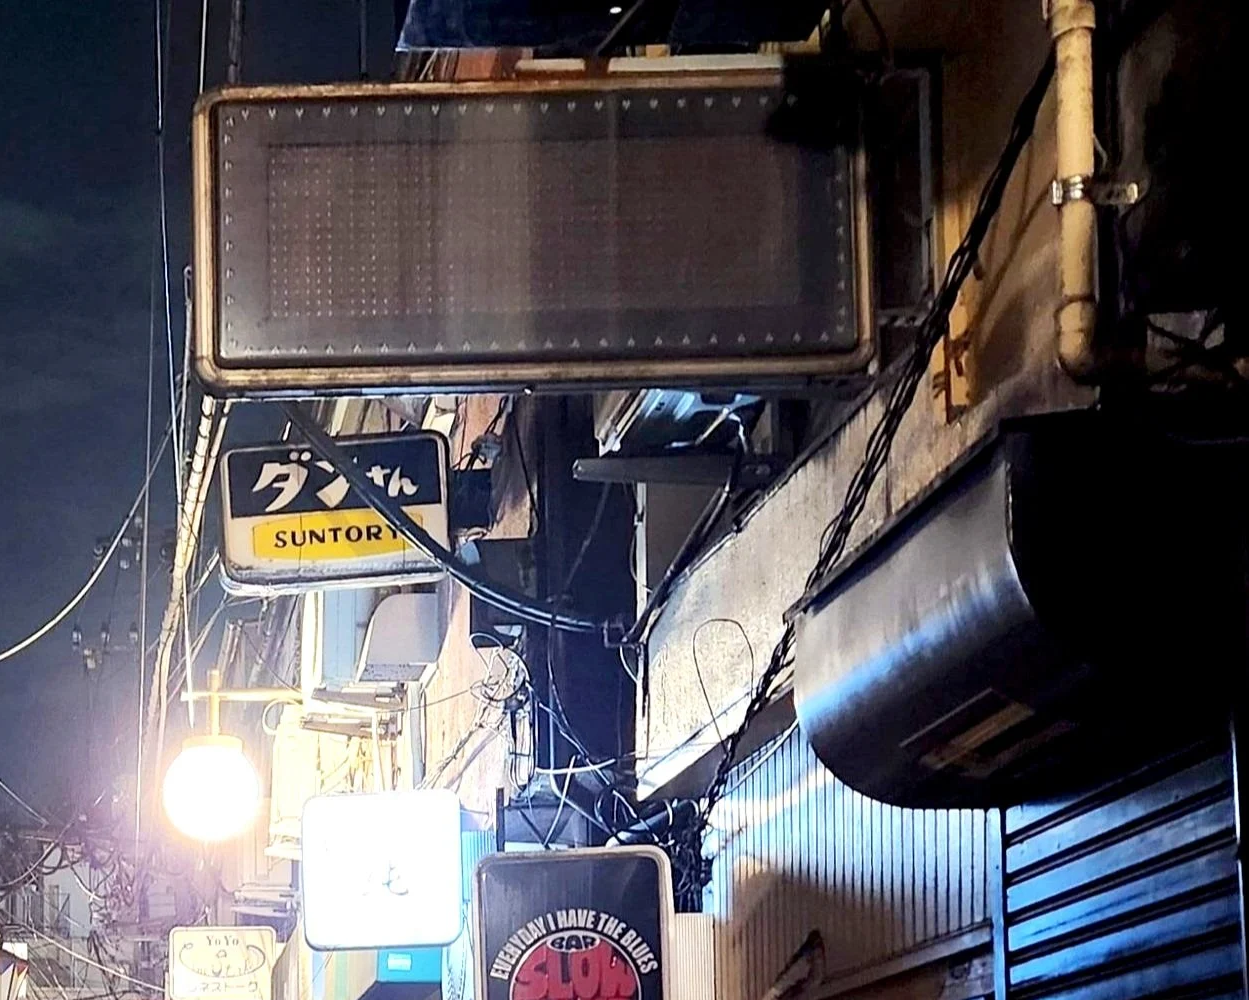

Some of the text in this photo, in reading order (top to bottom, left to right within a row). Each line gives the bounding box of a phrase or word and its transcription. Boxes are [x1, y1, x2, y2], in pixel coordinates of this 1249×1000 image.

[274, 525, 400, 549] SUNTORY
[490, 908, 659, 981] EVERYDAY I HAVE THE BLUES
[550, 935, 598, 950] BAR
